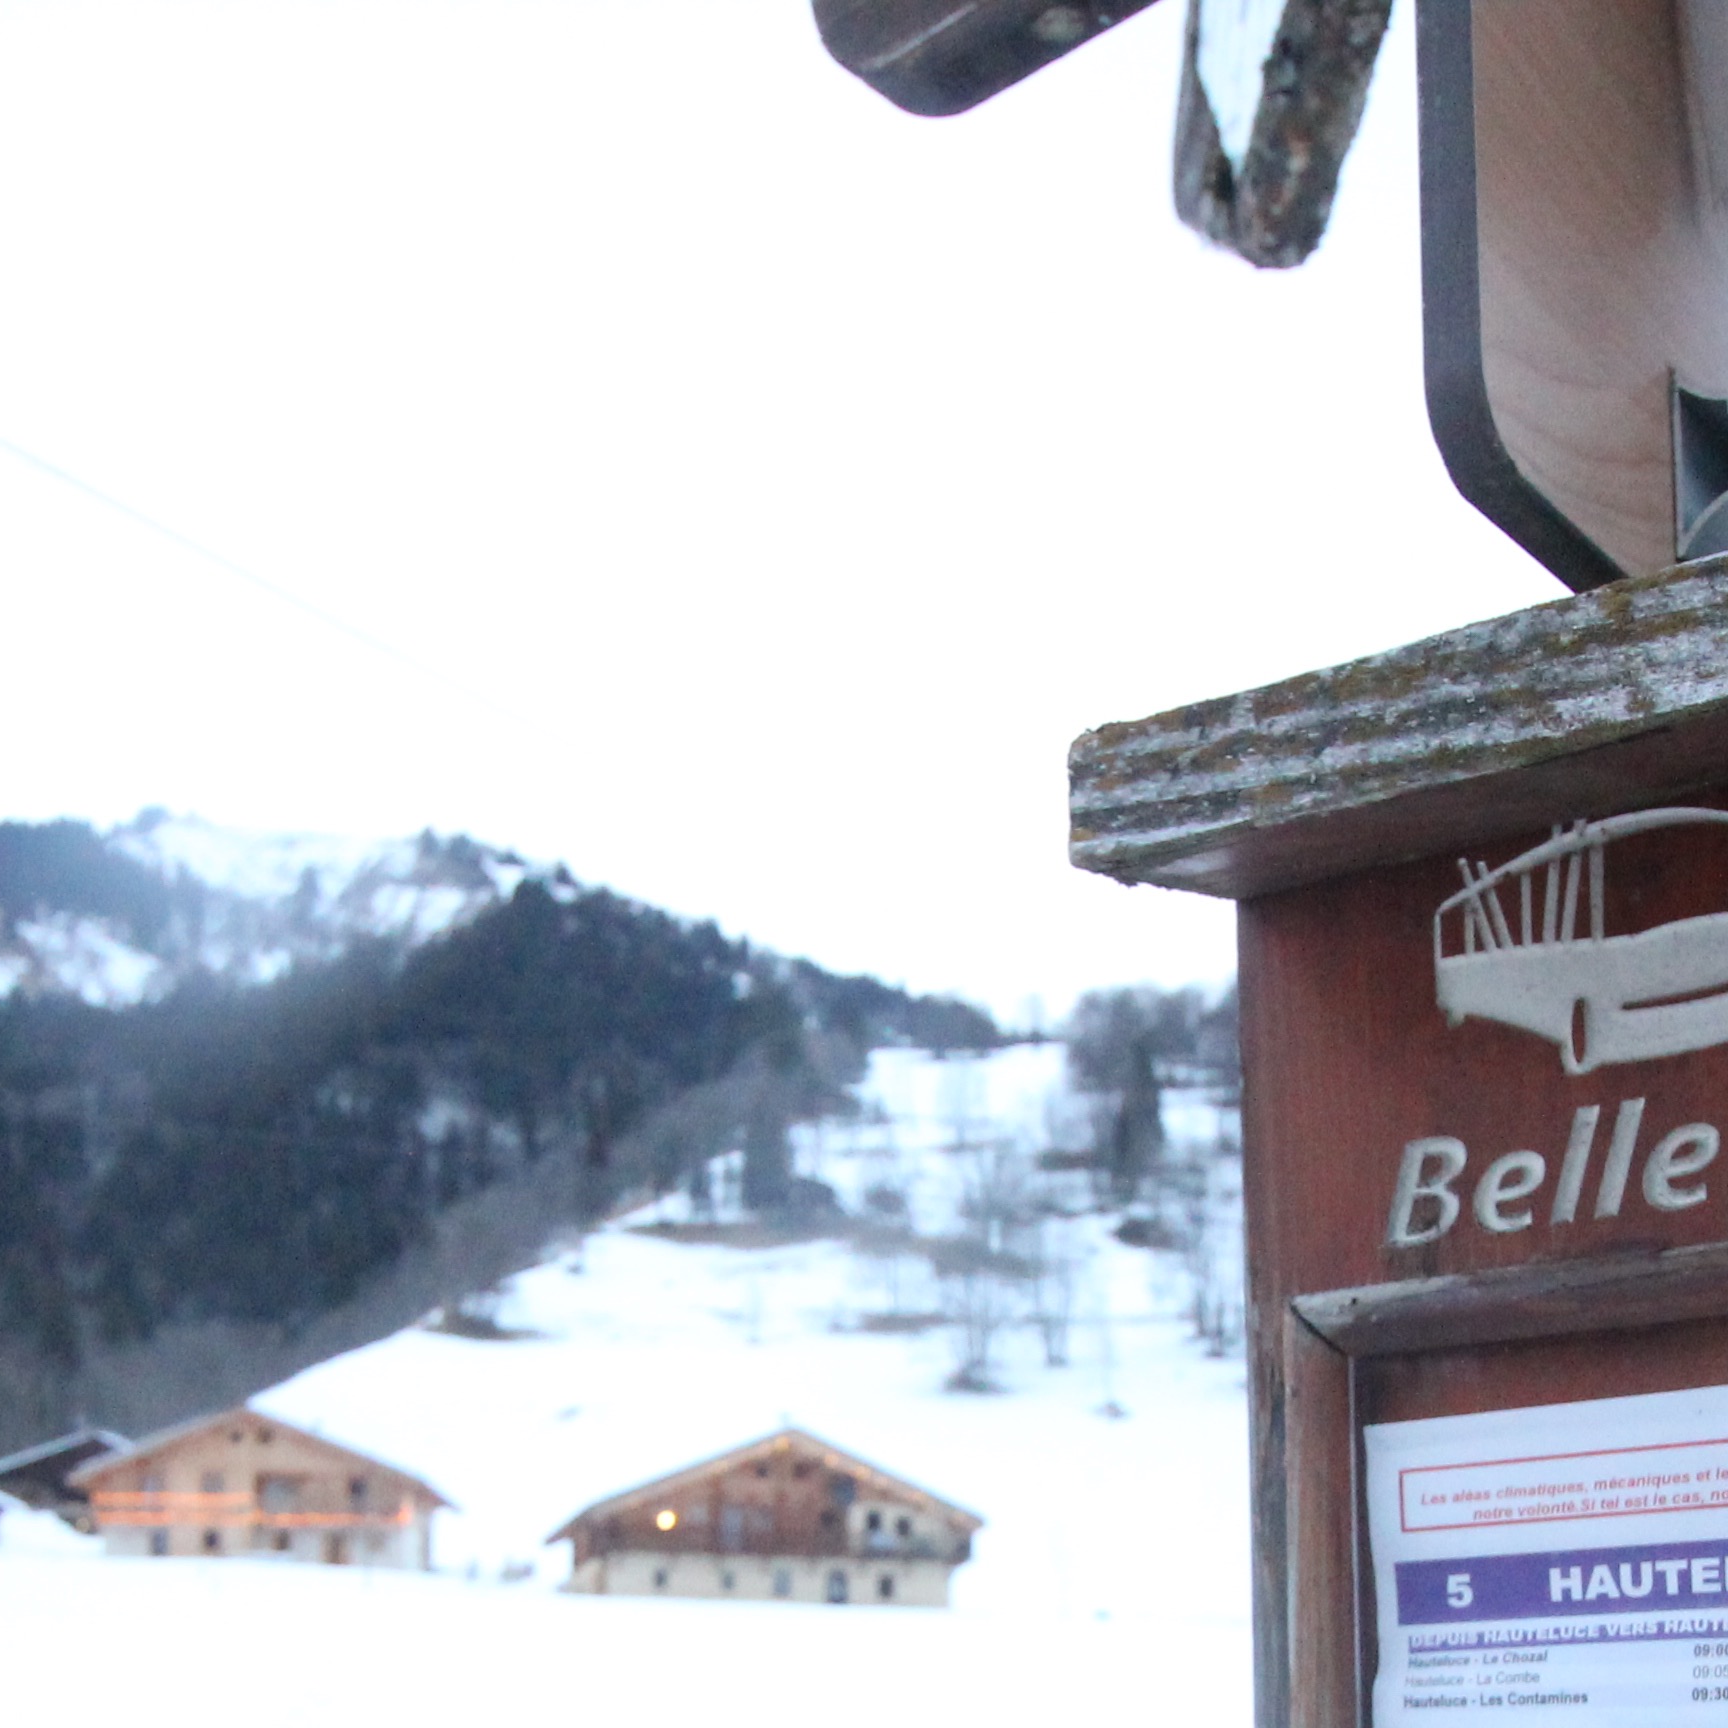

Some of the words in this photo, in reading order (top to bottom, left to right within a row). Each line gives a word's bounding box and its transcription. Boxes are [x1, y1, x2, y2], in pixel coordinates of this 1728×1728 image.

[1496, 1479, 1589, 1501] climatiques,
[1594, 1470, 1690, 1491] mécaniques
[1446, 1573, 1474, 1608] 5
[1484, 1625, 1601, 1643] HAUTELUCE
[1606, 1621, 1658, 1636] VERS
[1507, 1691, 1588, 1706] Contamines
